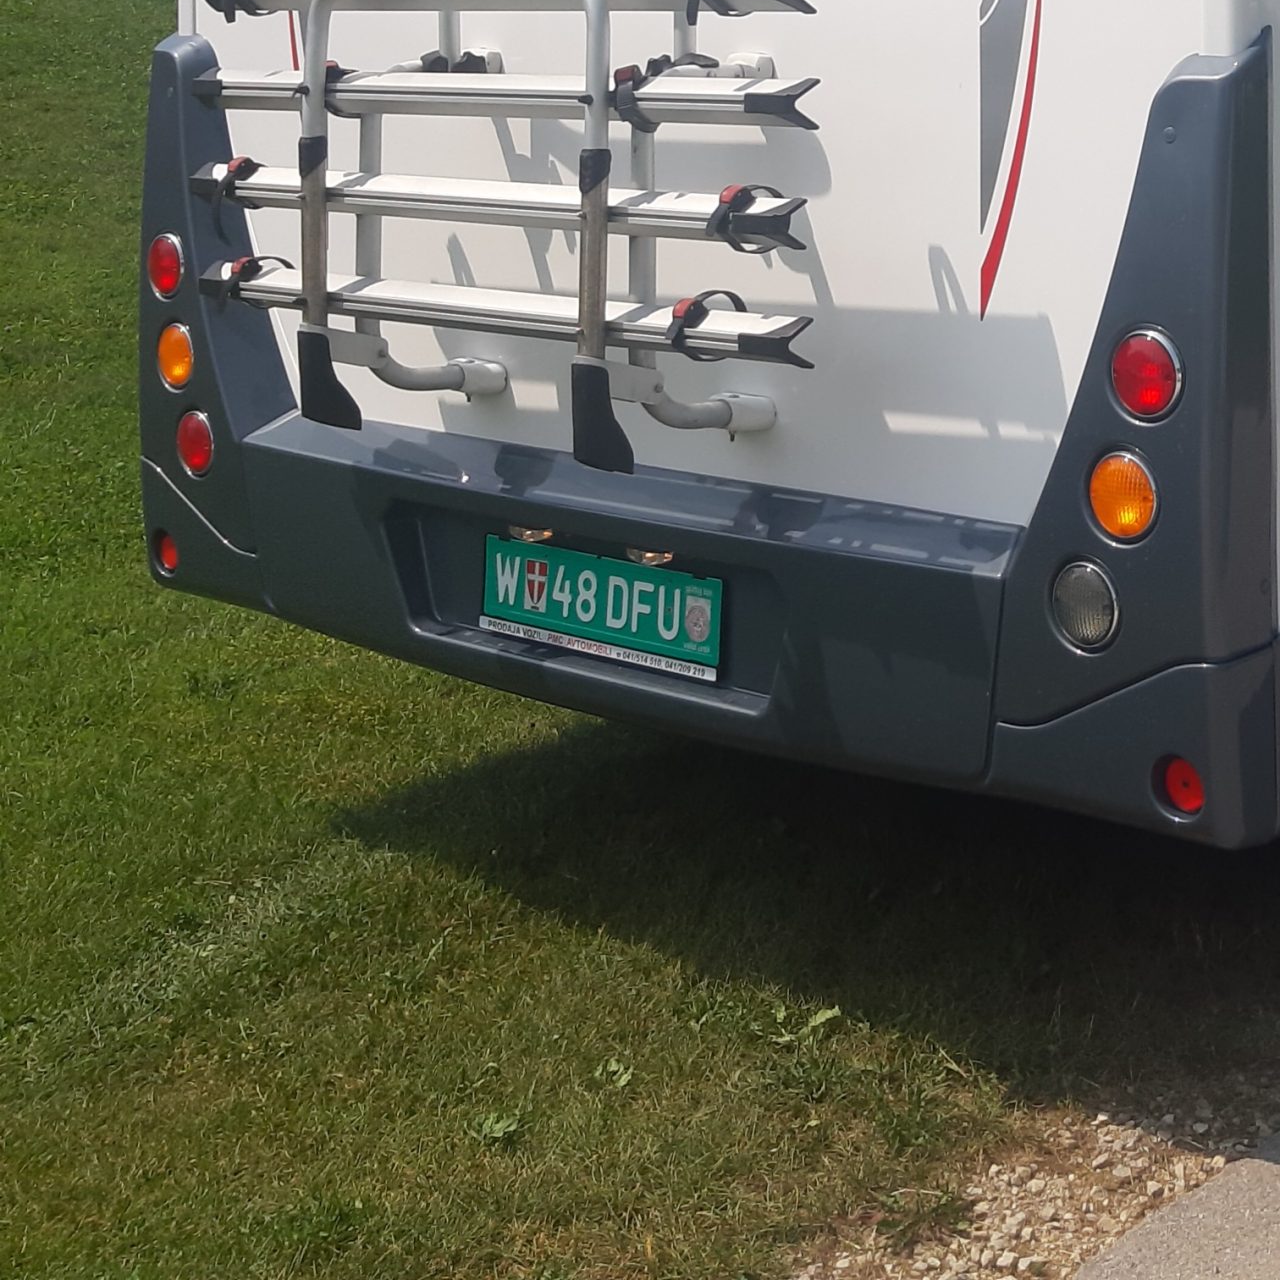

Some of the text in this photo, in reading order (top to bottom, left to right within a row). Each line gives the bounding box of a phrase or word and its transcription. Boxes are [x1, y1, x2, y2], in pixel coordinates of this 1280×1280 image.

[495, 552, 682, 641] W 48 DFU
[487, 619, 521, 635] PRODAJA
[522, 627, 543, 641] VOZIL
